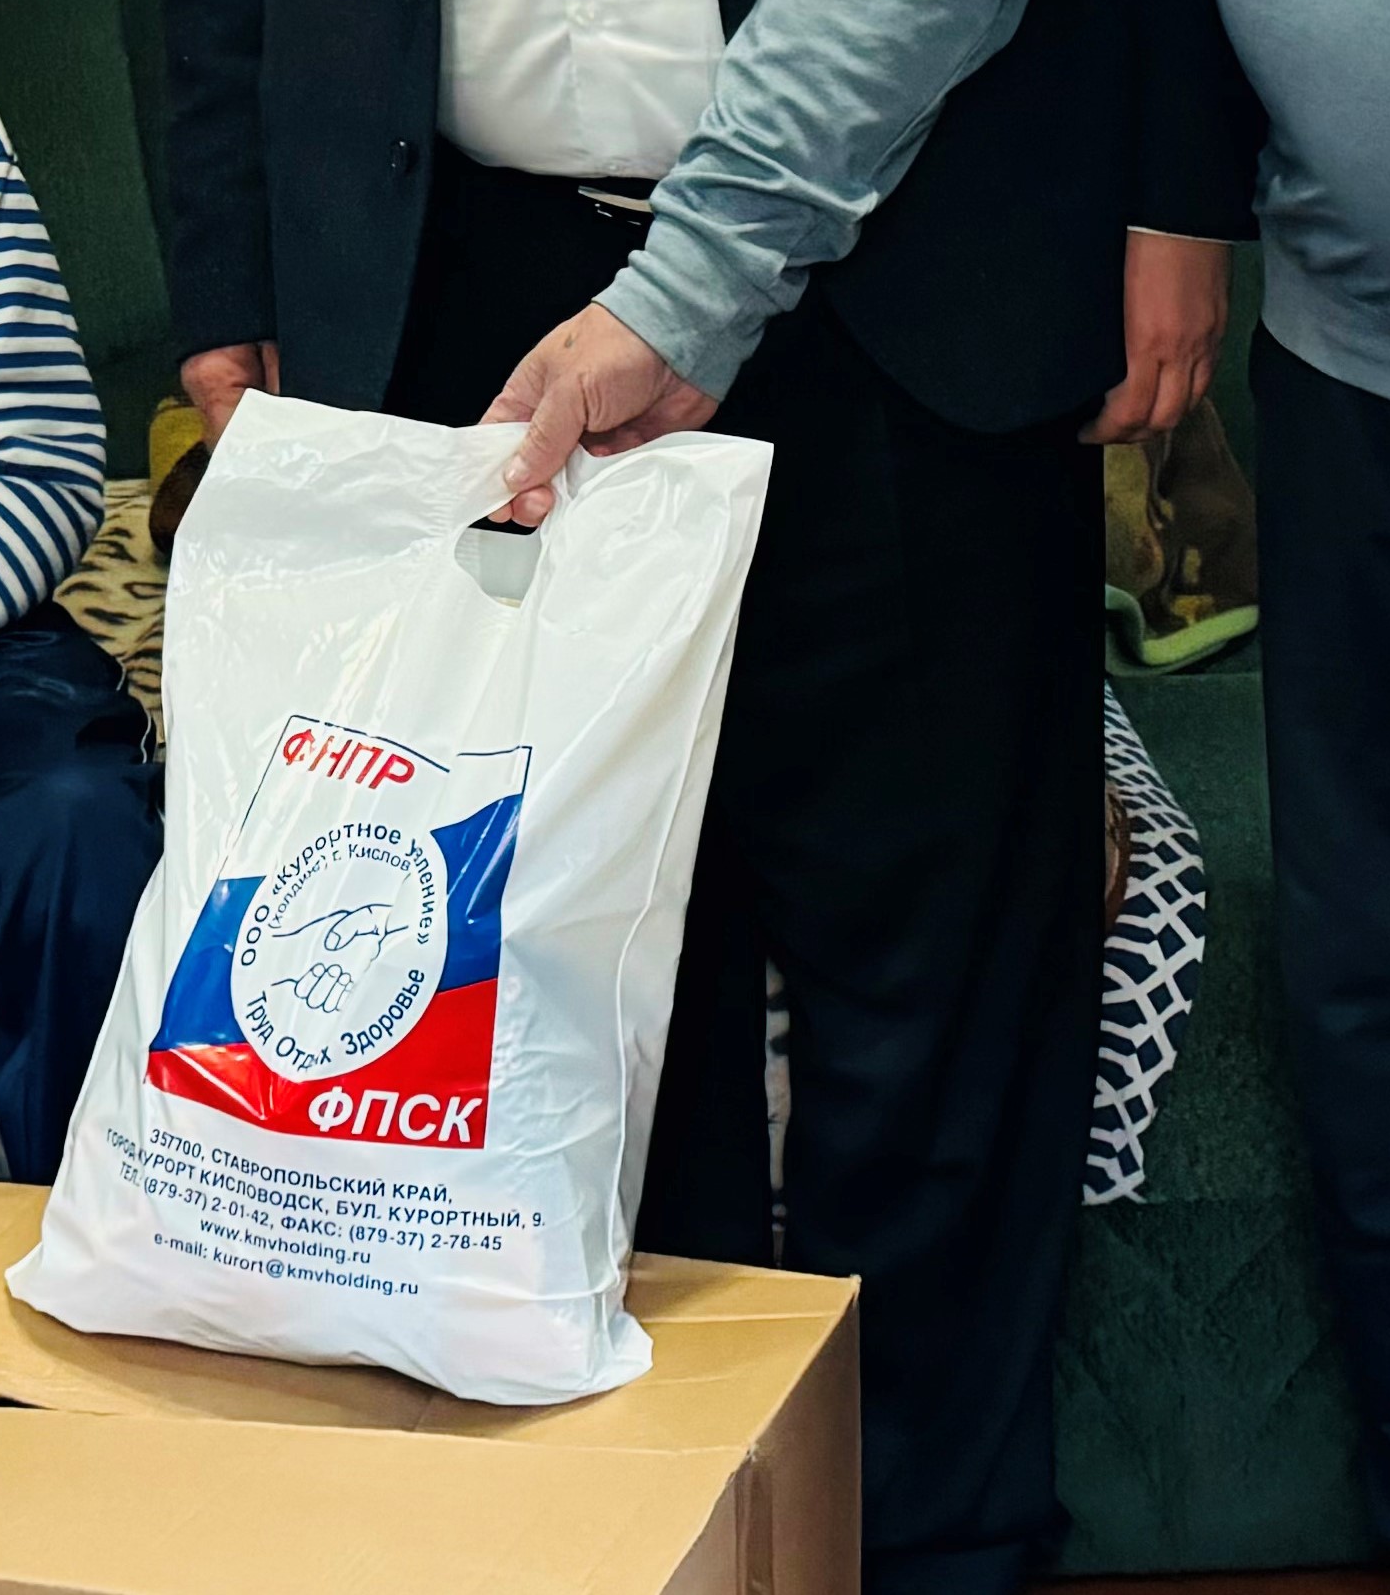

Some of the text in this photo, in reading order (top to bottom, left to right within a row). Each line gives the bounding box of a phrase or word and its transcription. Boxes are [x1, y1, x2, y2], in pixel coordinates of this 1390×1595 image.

[282, 729, 416, 790] ФНПР
[241, 905, 270, 966] ООО
[246, 969, 426, 1072] Труд Отдх Здоровье
[308, 1086, 483, 1143] ФПСК
[149, 1128, 453, 1204] 357700, СТАВРОПОЛЬСКИЙ КРАЙ,
[143, 1176, 208, 1211] (879-37)
[211, 1197, 275, 1230] 2-01-42,
[281, 1216, 342, 1238] ФАКС:
[349, 1225, 425, 1251] (879-37)
[431, 1234, 502, 1251] 2-78-45
[200, 1169, 330, 1216] КИСЛОВОДСК,
[336, 1200, 382, 1220] БУЛ.
[388, 1206, 526, 1230] КУРОРТНЫЙ,
[154, 1233, 419, 1296] e-mail: kurort@kmvholding.ru
[200, 1219, 371, 1265] www.kmvholding.ru
